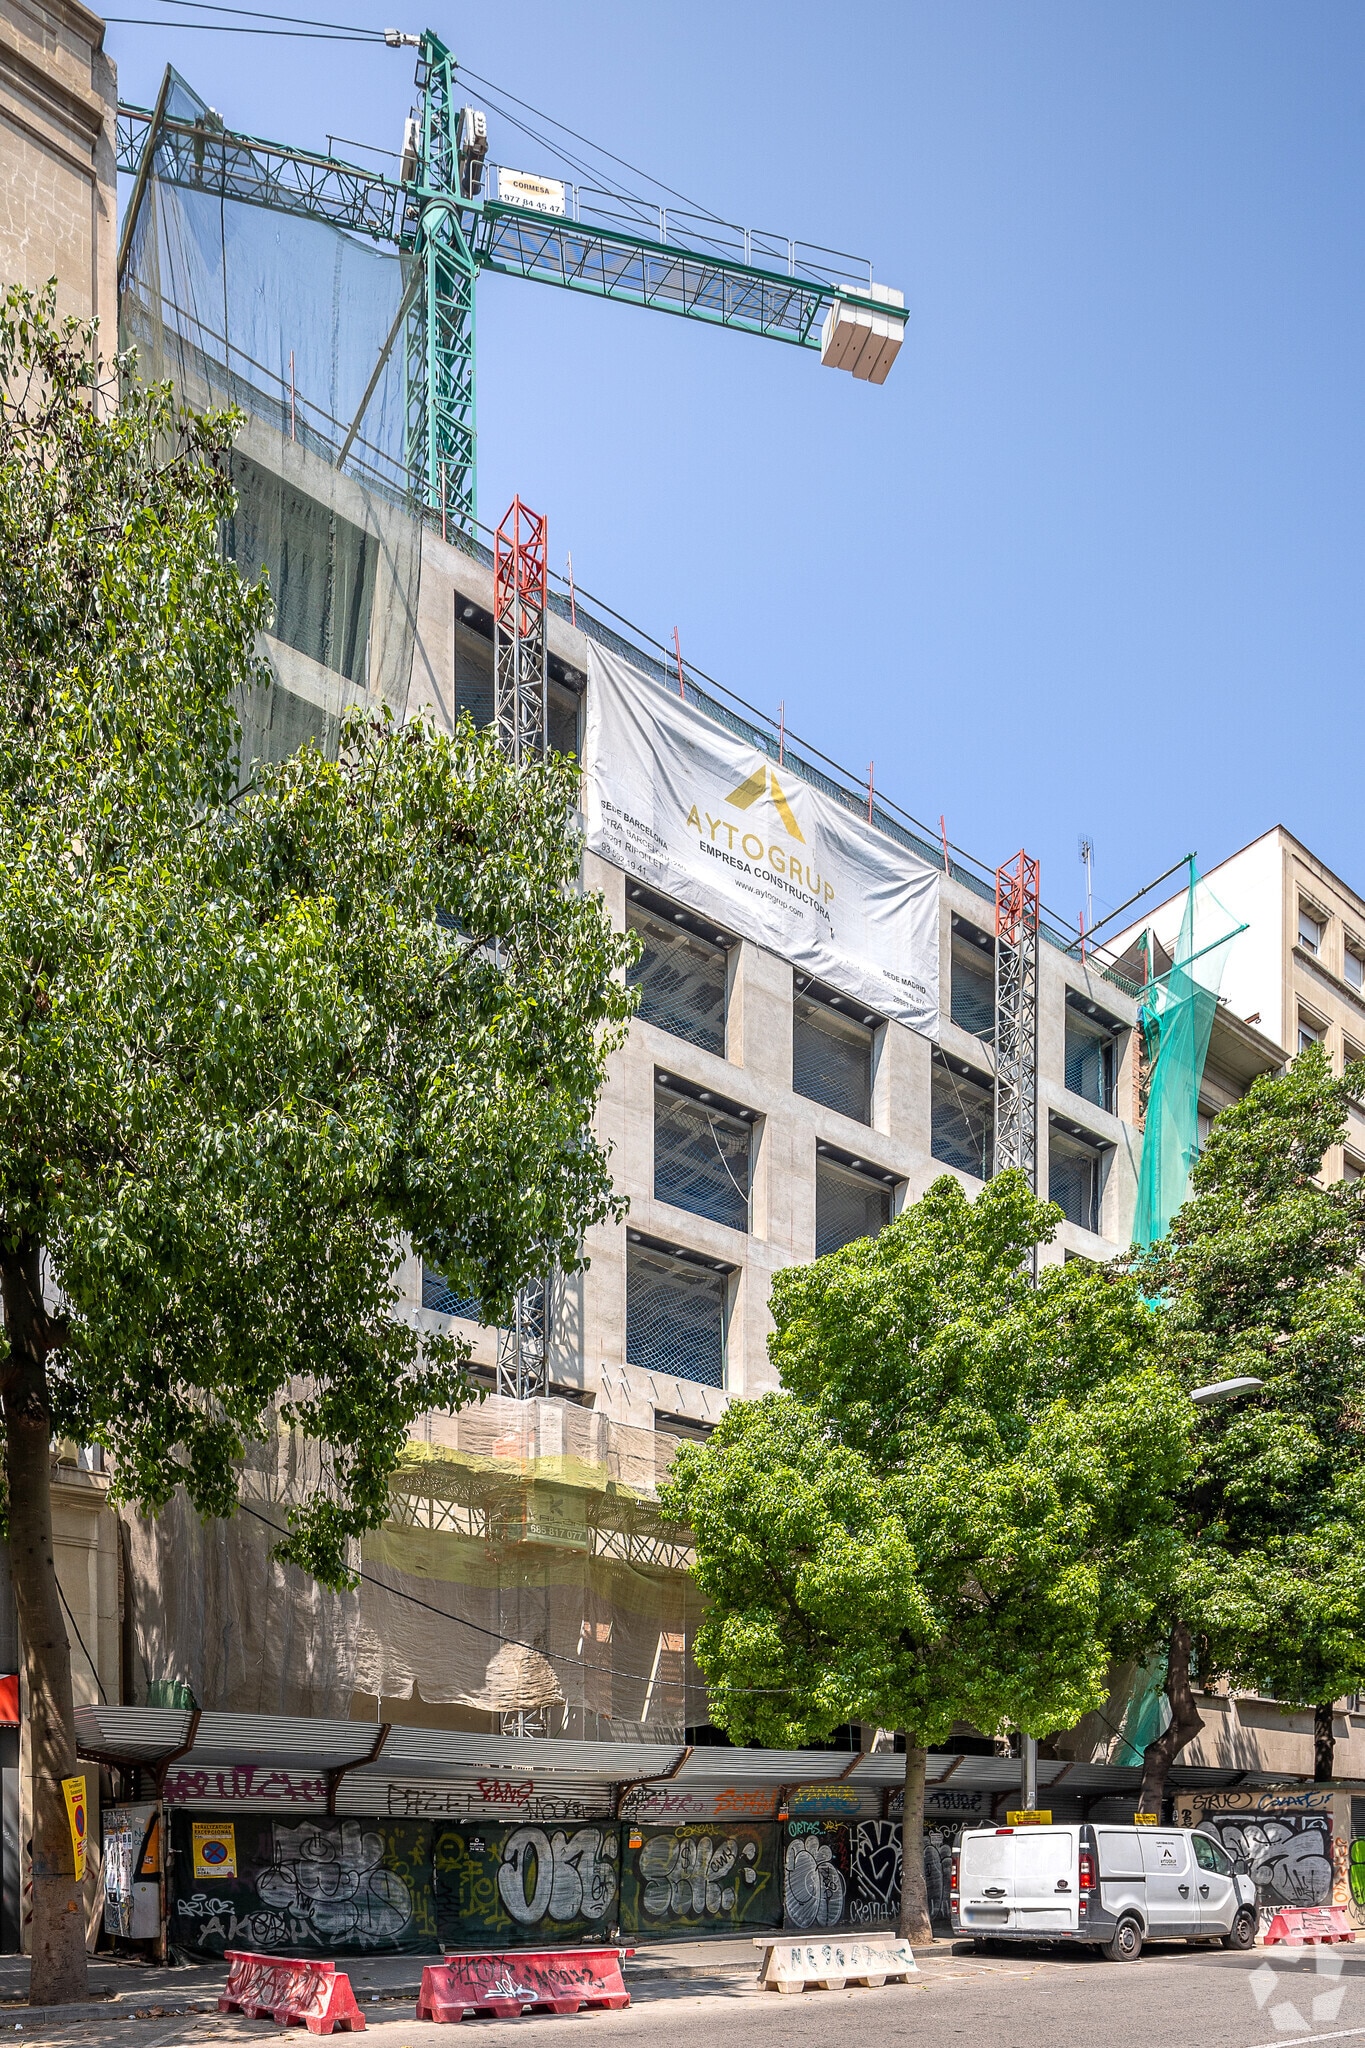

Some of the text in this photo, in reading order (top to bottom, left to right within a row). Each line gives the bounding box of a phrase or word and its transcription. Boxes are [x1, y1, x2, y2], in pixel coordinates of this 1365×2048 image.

[504, 194, 560, 213] 977 84 45 47
[513, 181, 550, 195] CORMESA
[623, 813, 668, 851] BARCELONA
[601, 841, 611, 853] 93
[637, 865, 647, 875] 41
[686, 804, 835, 904] AYTOGRUP
[700, 840, 831, 922] EMPRESA CONSTRUCTORA
[734, 879, 804, 919] www.aytogrup.com
[901, 978, 927, 995] MADRID
[530, 1524, 583, 1541] 685 817 077
